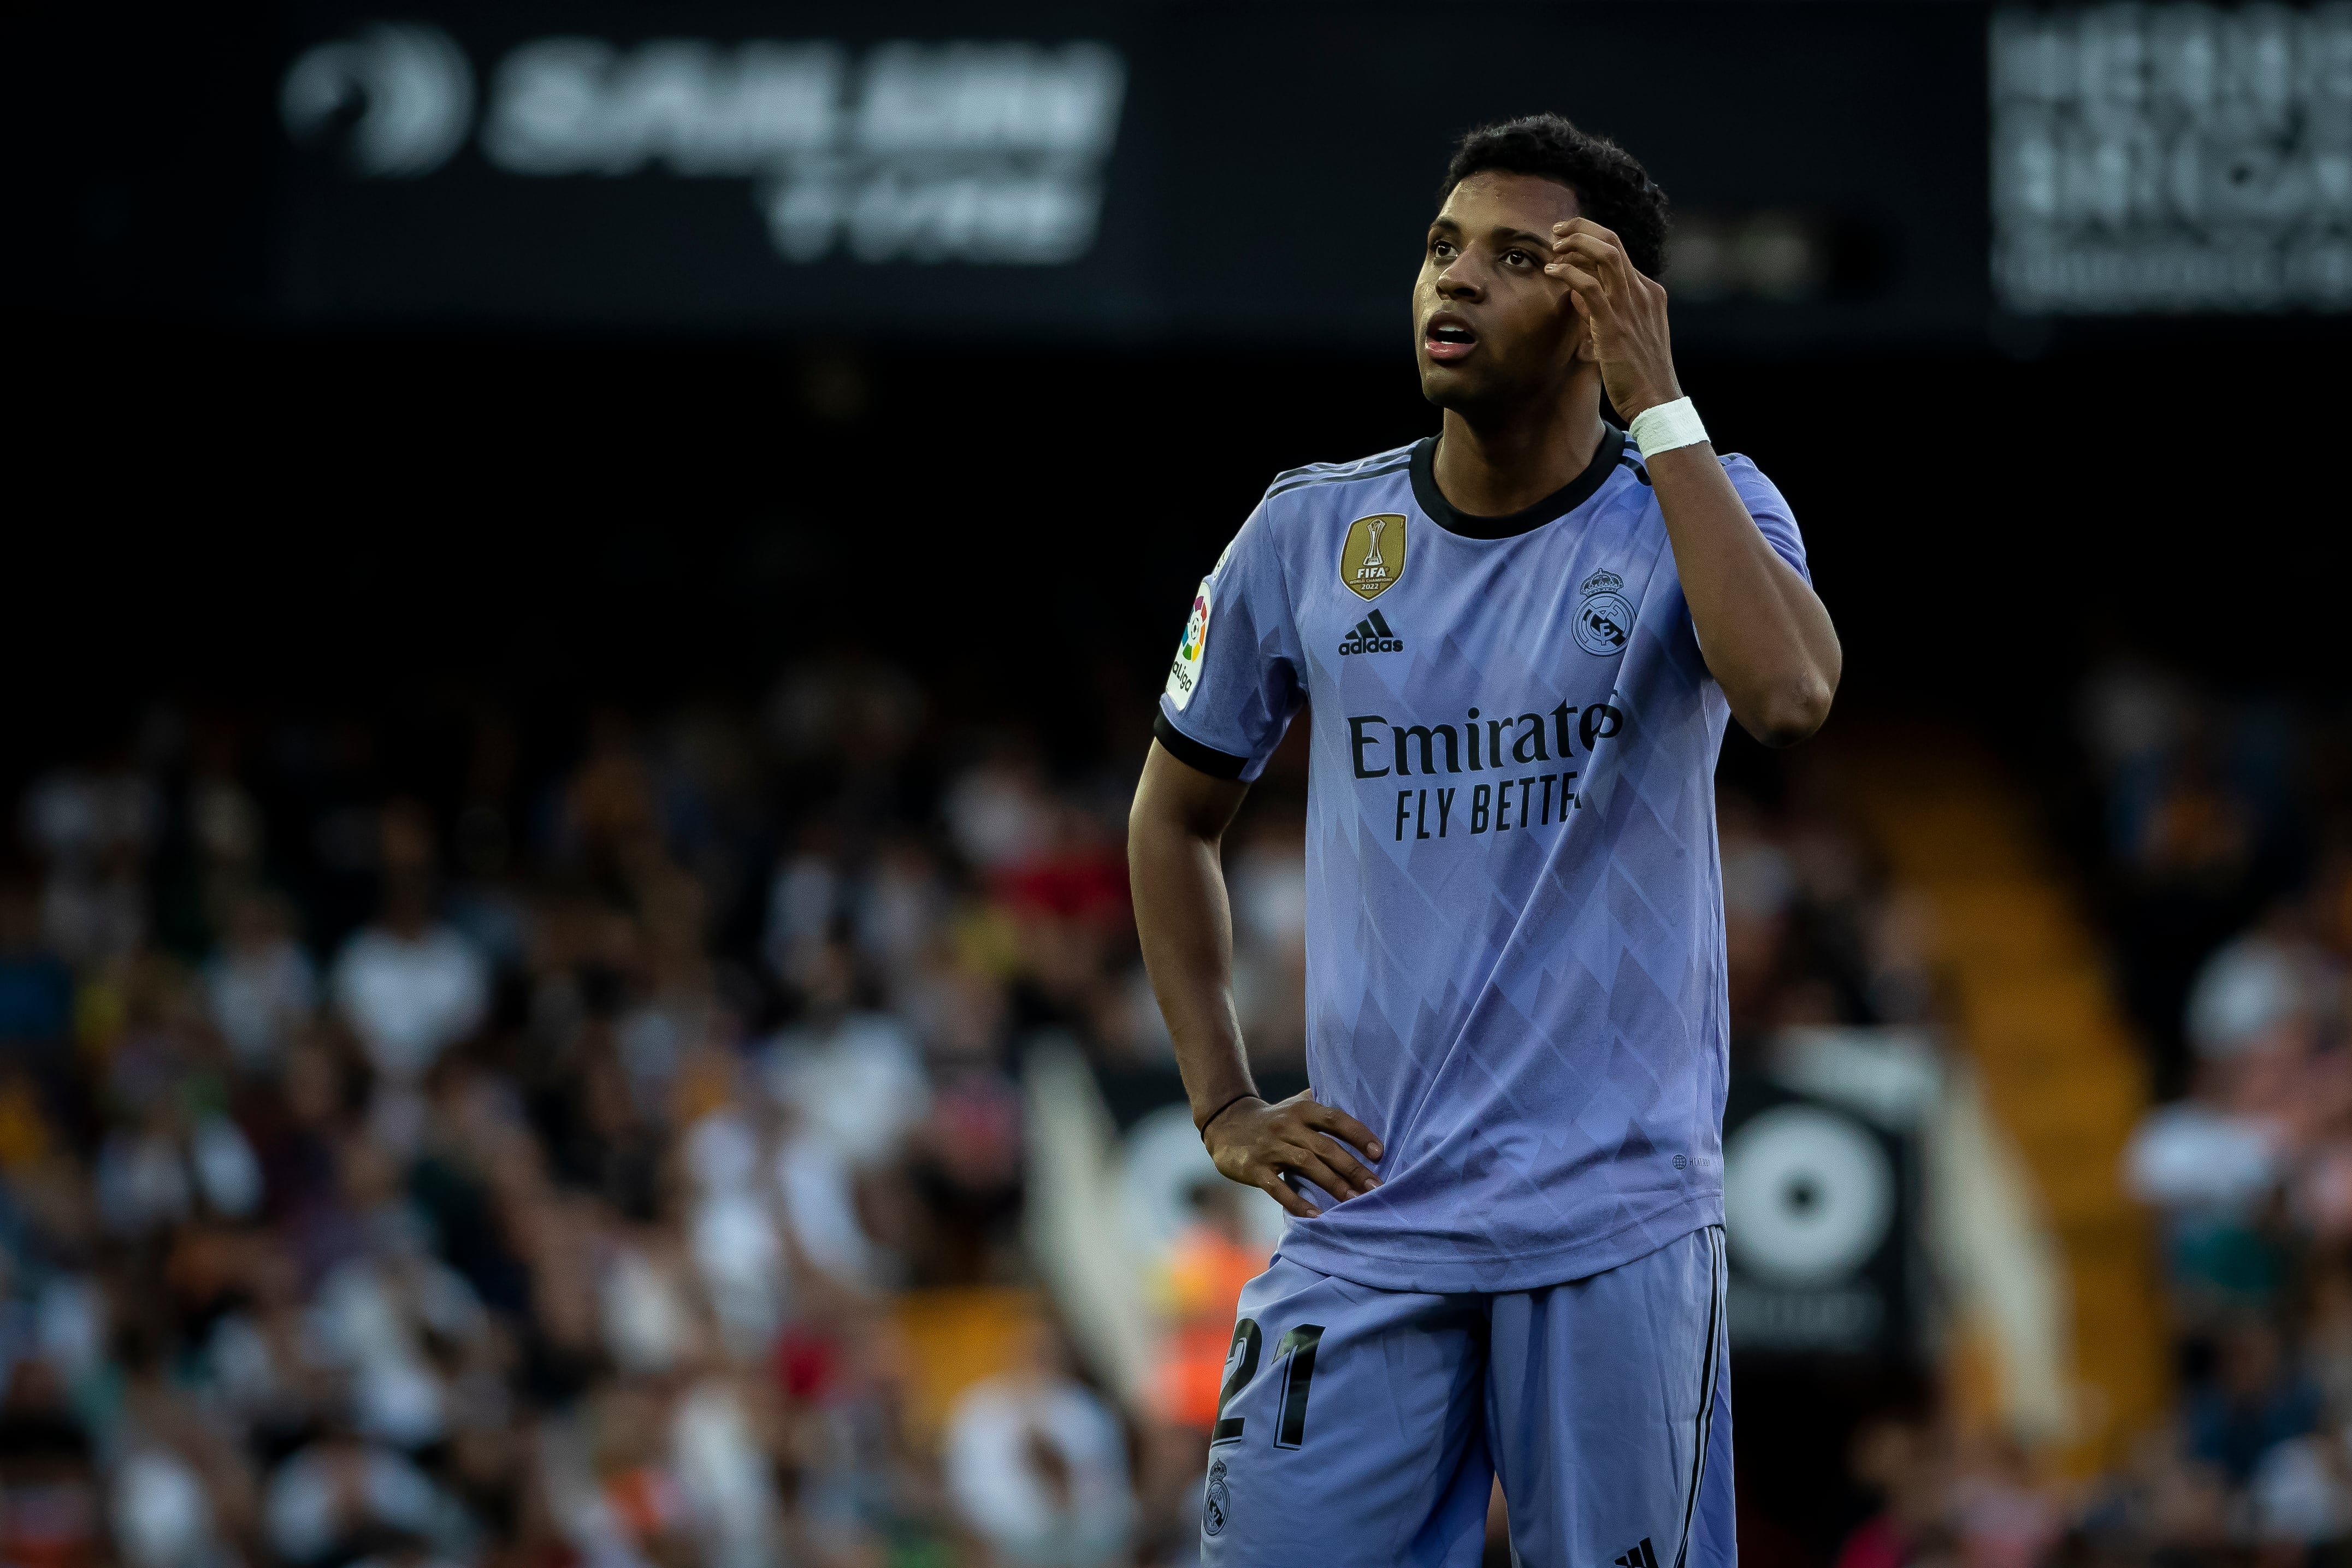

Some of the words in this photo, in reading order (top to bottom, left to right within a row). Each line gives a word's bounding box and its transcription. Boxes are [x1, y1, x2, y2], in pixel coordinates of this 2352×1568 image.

[1357, 567, 1386, 578] FIFA
[1338, 637, 1404, 656] adidas
[1172, 661, 1192, 693] aLiga
[1395, 786, 1456, 841] FLY
[1470, 768, 1582, 835] BETTE
[1210, 1318, 1326, 1451] 21
